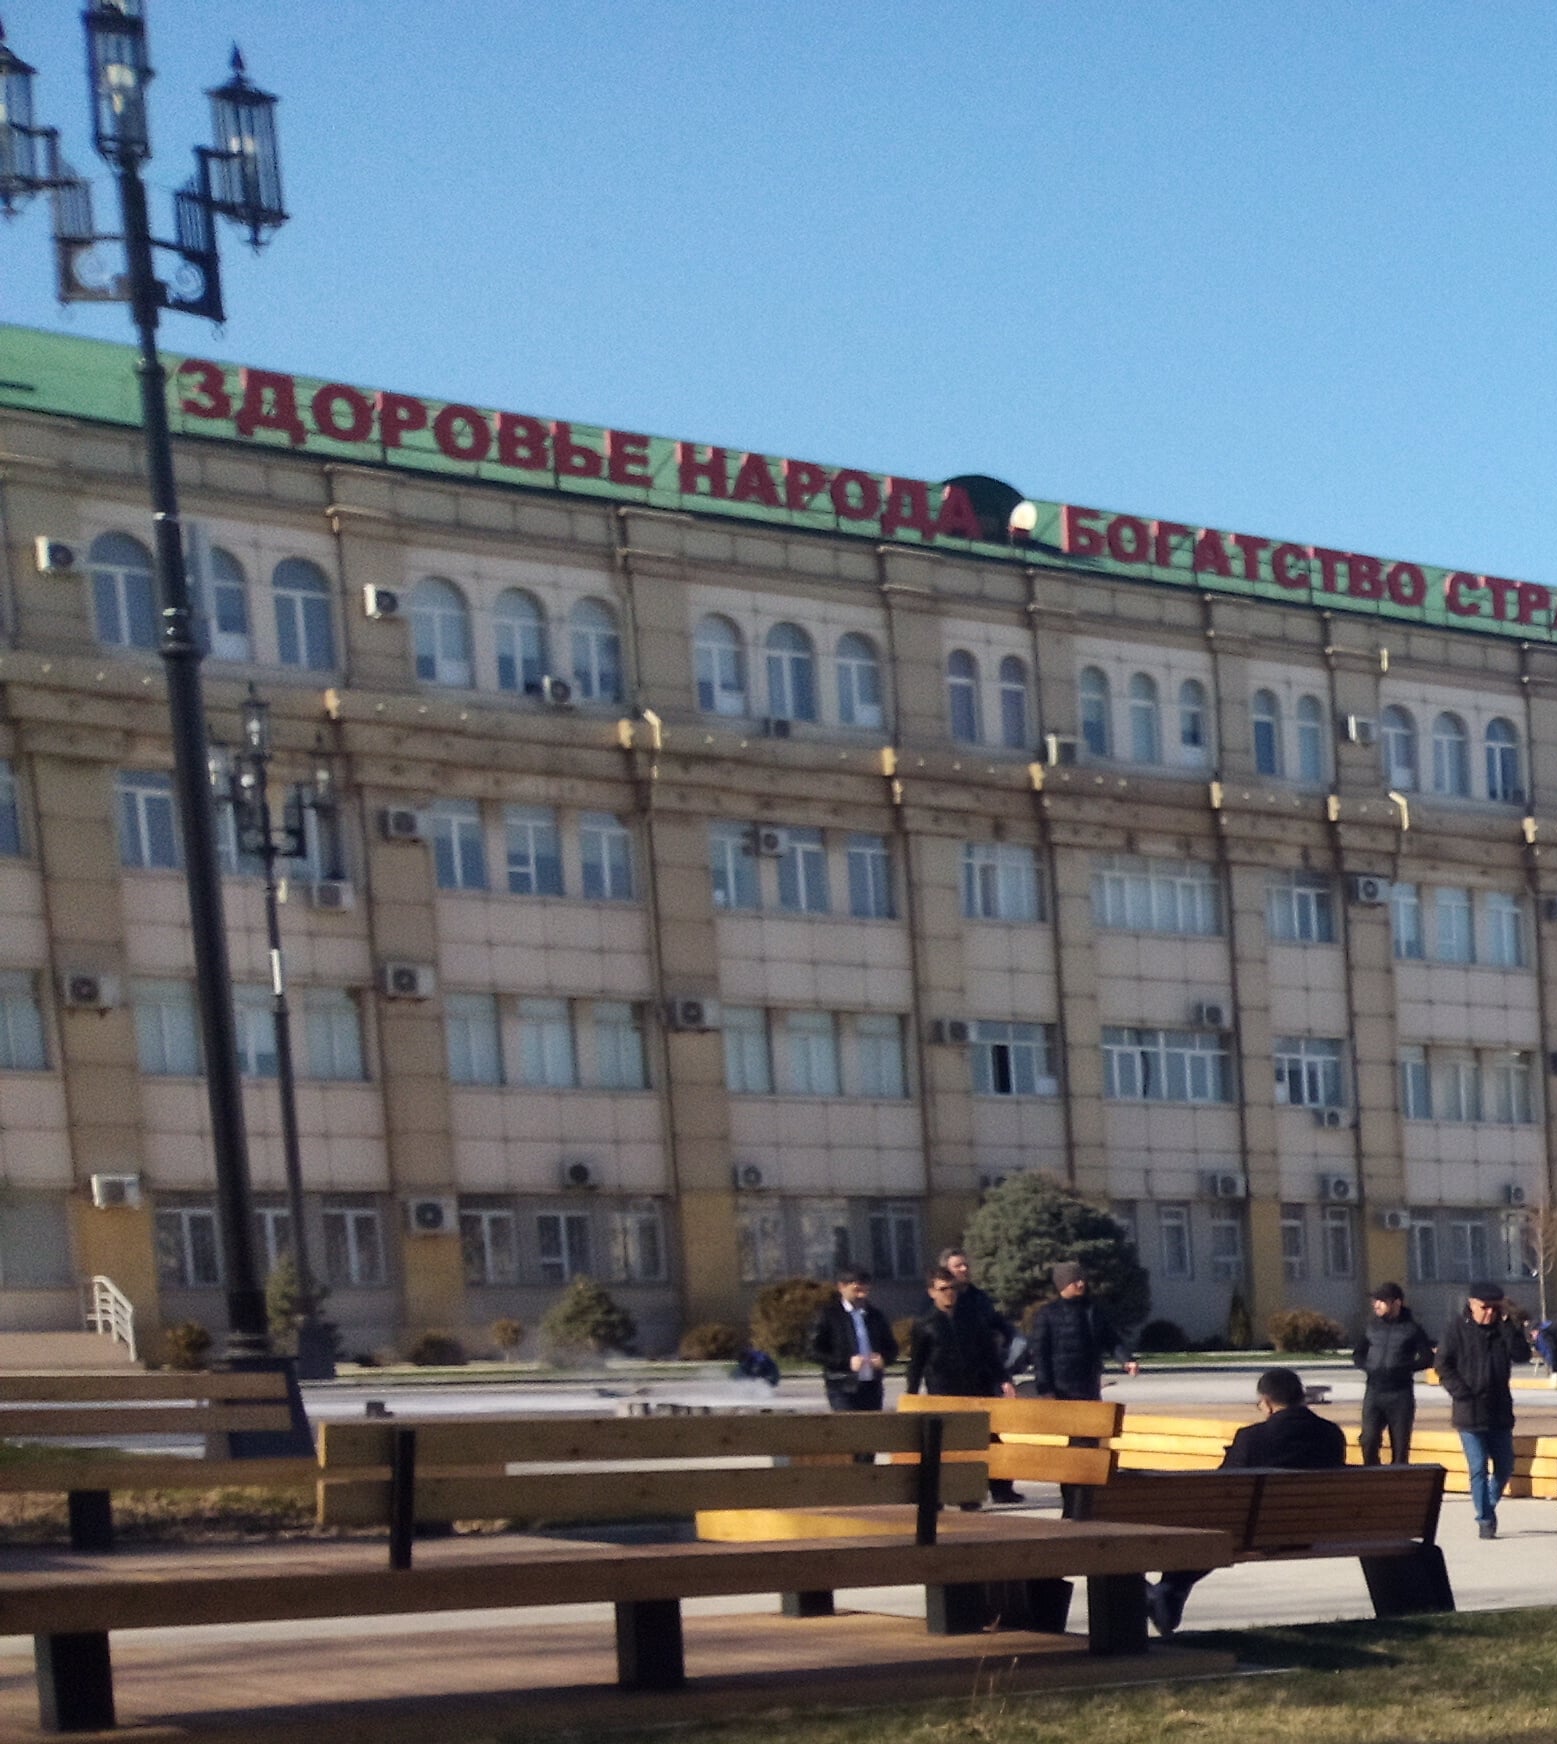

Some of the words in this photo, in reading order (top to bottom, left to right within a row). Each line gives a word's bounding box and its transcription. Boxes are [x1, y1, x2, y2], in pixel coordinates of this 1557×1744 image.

[174, 359, 656, 488] ЗДОРОВЬЕ
[675, 440, 984, 541] НАРОДА
[1061, 504, 1427, 608] БОГАТСТВО
